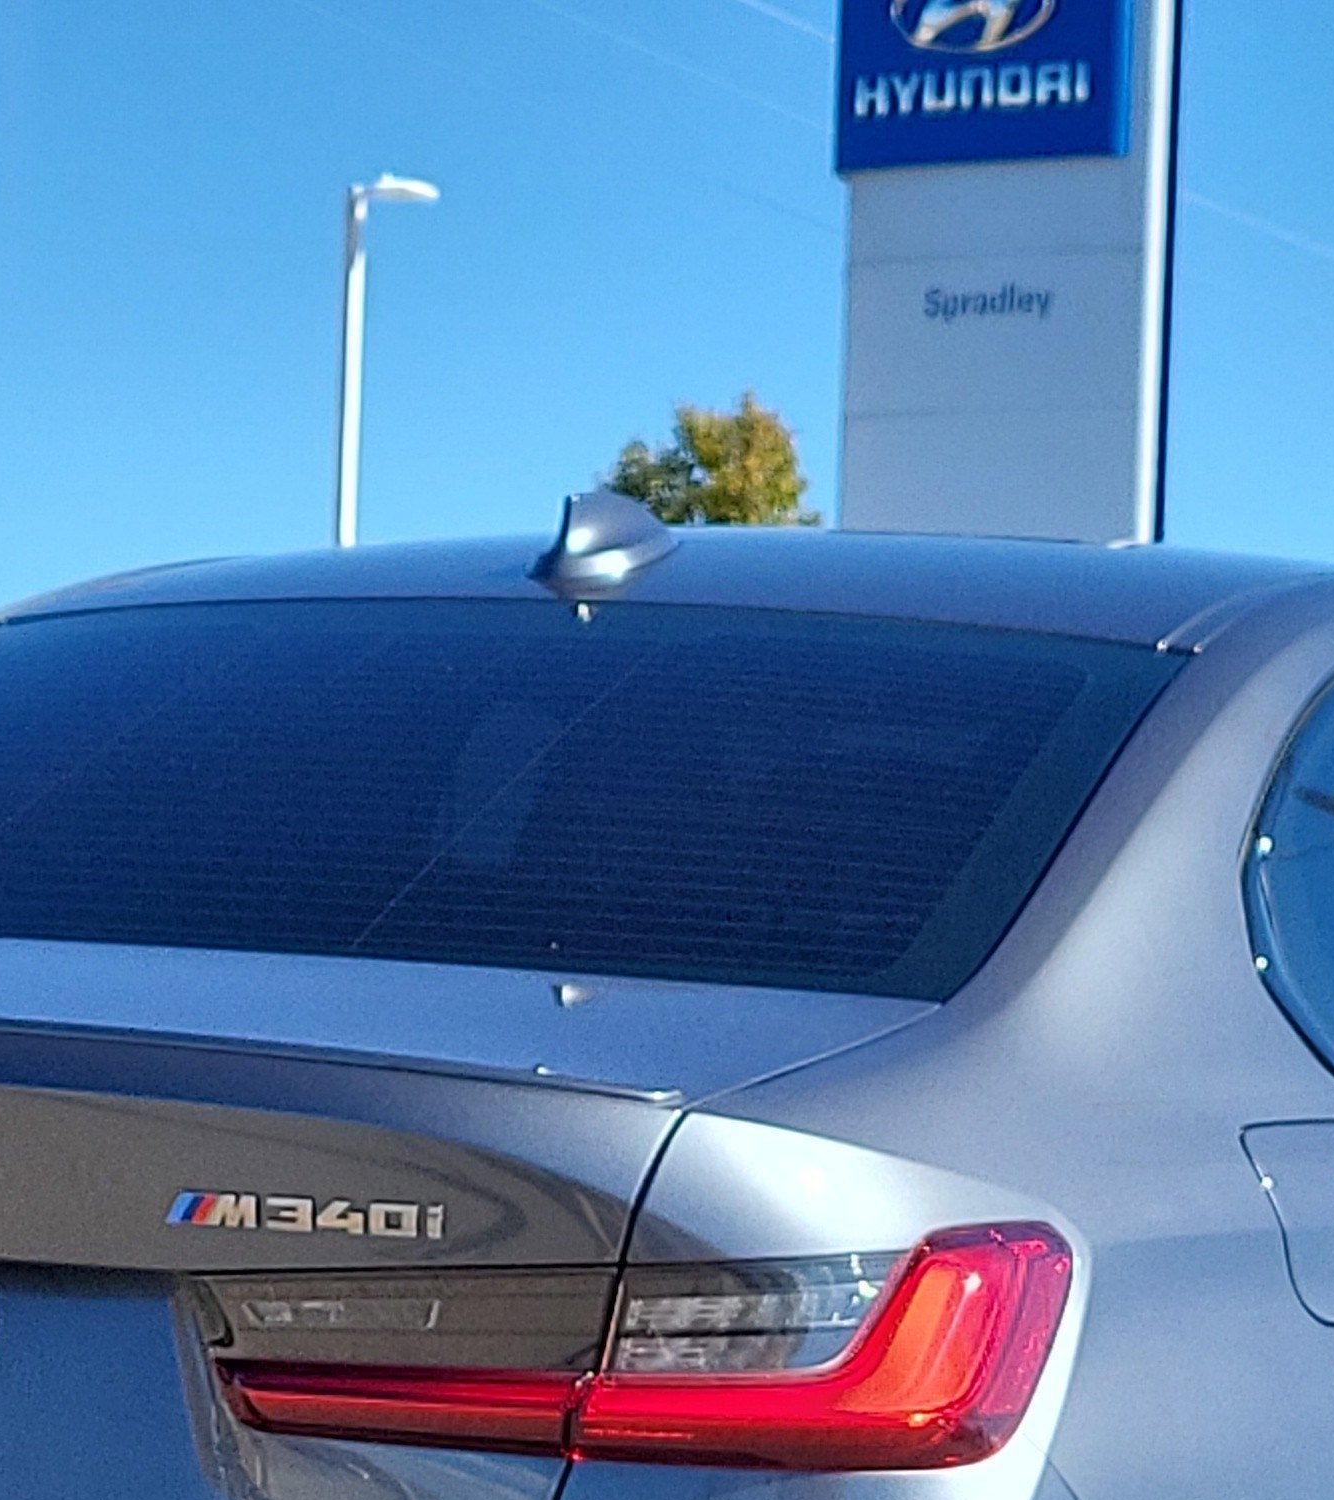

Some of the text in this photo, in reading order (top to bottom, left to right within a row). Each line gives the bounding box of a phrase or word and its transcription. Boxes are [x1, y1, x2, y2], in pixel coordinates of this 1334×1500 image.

[854, 61, 1091, 118] HYUNDAI
[924, 285, 1051, 322] Spradley
[209, 1193, 443, 1240] M340i
